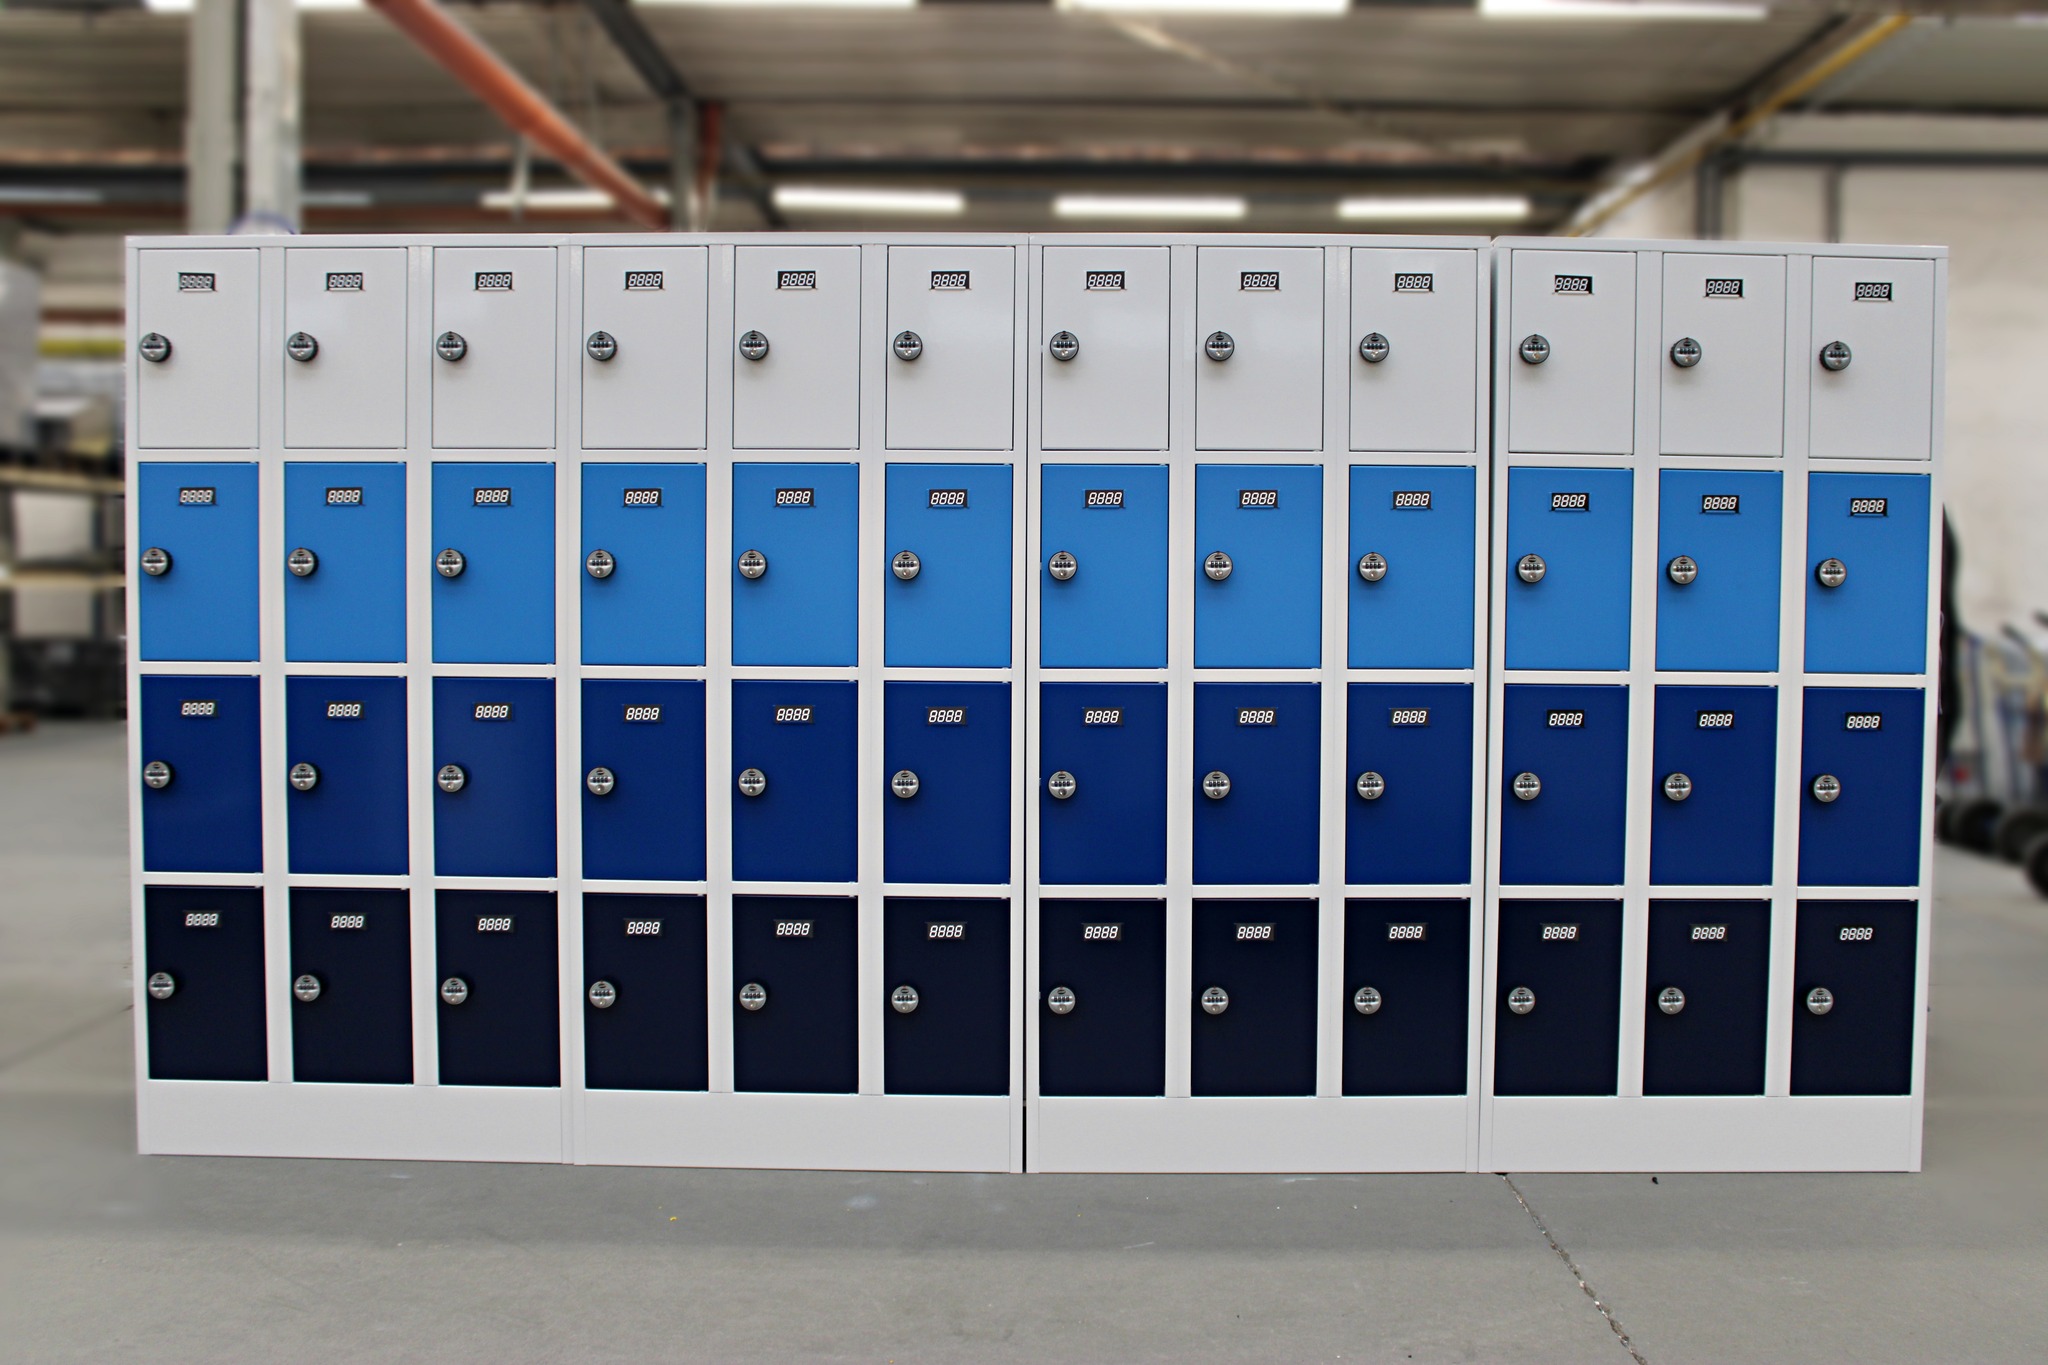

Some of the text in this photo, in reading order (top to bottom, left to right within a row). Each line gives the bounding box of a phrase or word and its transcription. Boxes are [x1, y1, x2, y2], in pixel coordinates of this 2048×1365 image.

[328, 275, 361, 287] 8888
[478, 274, 511, 287] 8888
[628, 274, 661, 286] 8888
[781, 273, 815, 286] 8888
[932, 274, 966, 286] 8888
[1088, 274, 1121, 287] 8888
[1243, 274, 1277, 287] 8888
[1397, 276, 1431, 289] 8888
[1555, 278, 1588, 290] 8888
[1706, 282, 1739, 294] 8888
[1857, 284, 1889, 297] 8888
[180, 490, 213, 503] 8888
[327, 490, 360, 503] 8888
[475, 490, 509, 503] 8888
[625, 491, 658, 504] 8888
[777, 491, 811, 504] 8888
[931, 492, 964, 505] 8888
[1088, 492, 1122, 505] 8888
[1241, 492, 1276, 505] 8888
[1396, 493, 1429, 506] 8888
[1552, 495, 1585, 507] 8888
[1703, 497, 1736, 509] 8888
[1851, 500, 1884, 512] 8888
[181, 703, 214, 715] 8888
[327, 704, 360, 717] 8888
[475, 706, 508, 718] 8888
[626, 708, 659, 720] 8888
[776, 708, 810, 721] 8888
[928, 710, 962, 722] 8888
[1085, 711, 1119, 723] 8888
[1239, 711, 1273, 723] 8888
[1392, 711, 1427, 723] 8888
[1549, 713, 1582, 725] 8888
[1699, 714, 1732, 727] 8888
[1847, 716, 1880, 729] 8888
[185, 913, 218, 926] 8888
[331, 916, 364, 928] 8888
[478, 918, 511, 931] 8888
[627, 922, 660, 934] 8888
[776, 923, 810, 935] 8888
[929, 925, 963, 938] 8888
[1084, 926, 1118, 939] 8888
[1237, 927, 1271, 939] 8888
[1389, 927, 1423, 939] 8888
[1543, 927, 1576, 940] 8888
[1692, 927, 1725, 940] 8888
[1840, 928, 1873, 940] 8888
